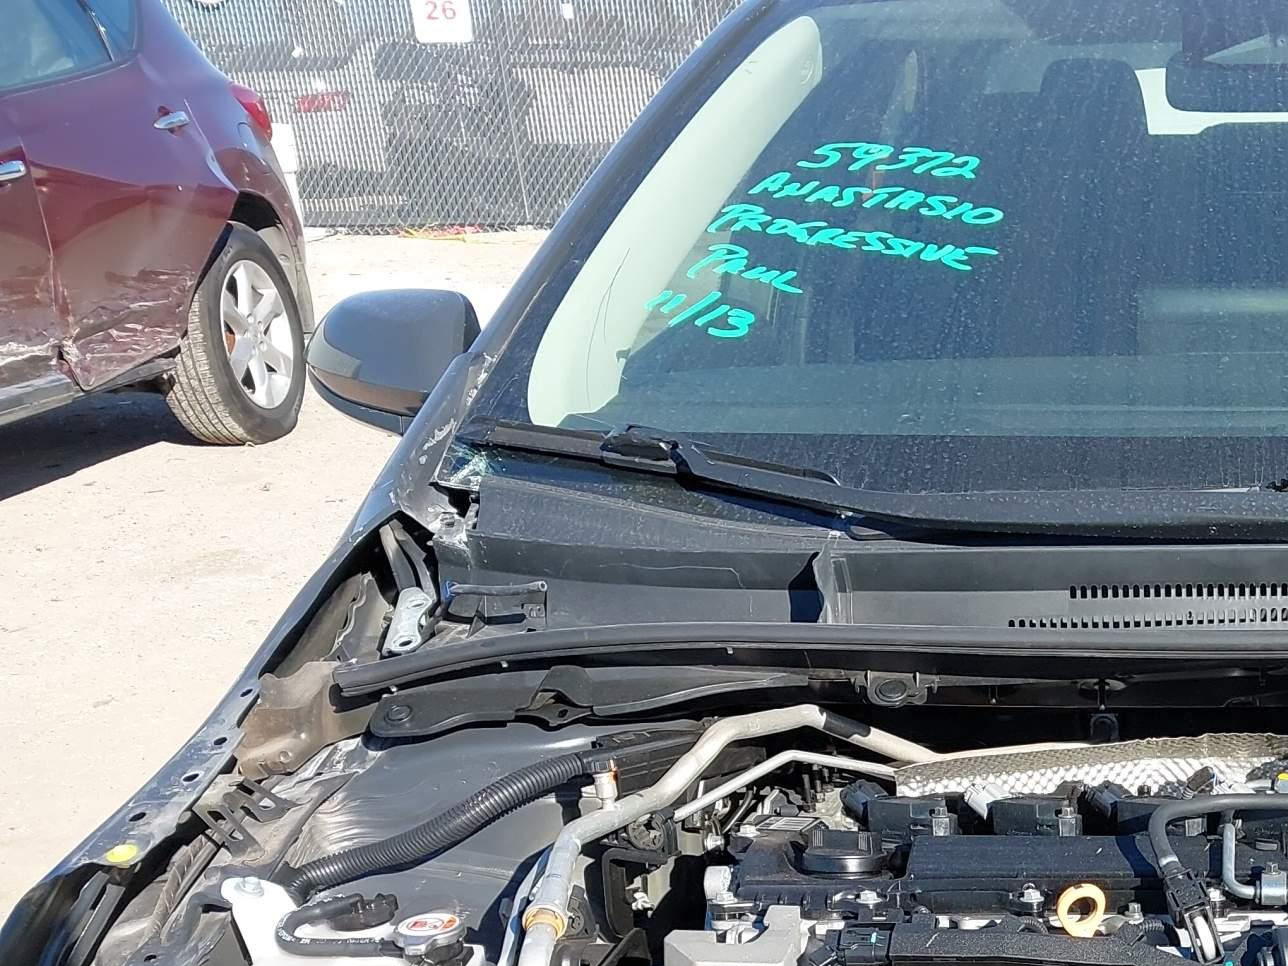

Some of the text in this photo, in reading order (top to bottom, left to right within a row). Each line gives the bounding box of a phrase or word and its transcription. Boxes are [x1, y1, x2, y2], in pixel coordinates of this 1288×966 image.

[424, 0, 457, 20] 26
[797, 142, 981, 179] 59372
[644, 289, 756, 339] 11/13
